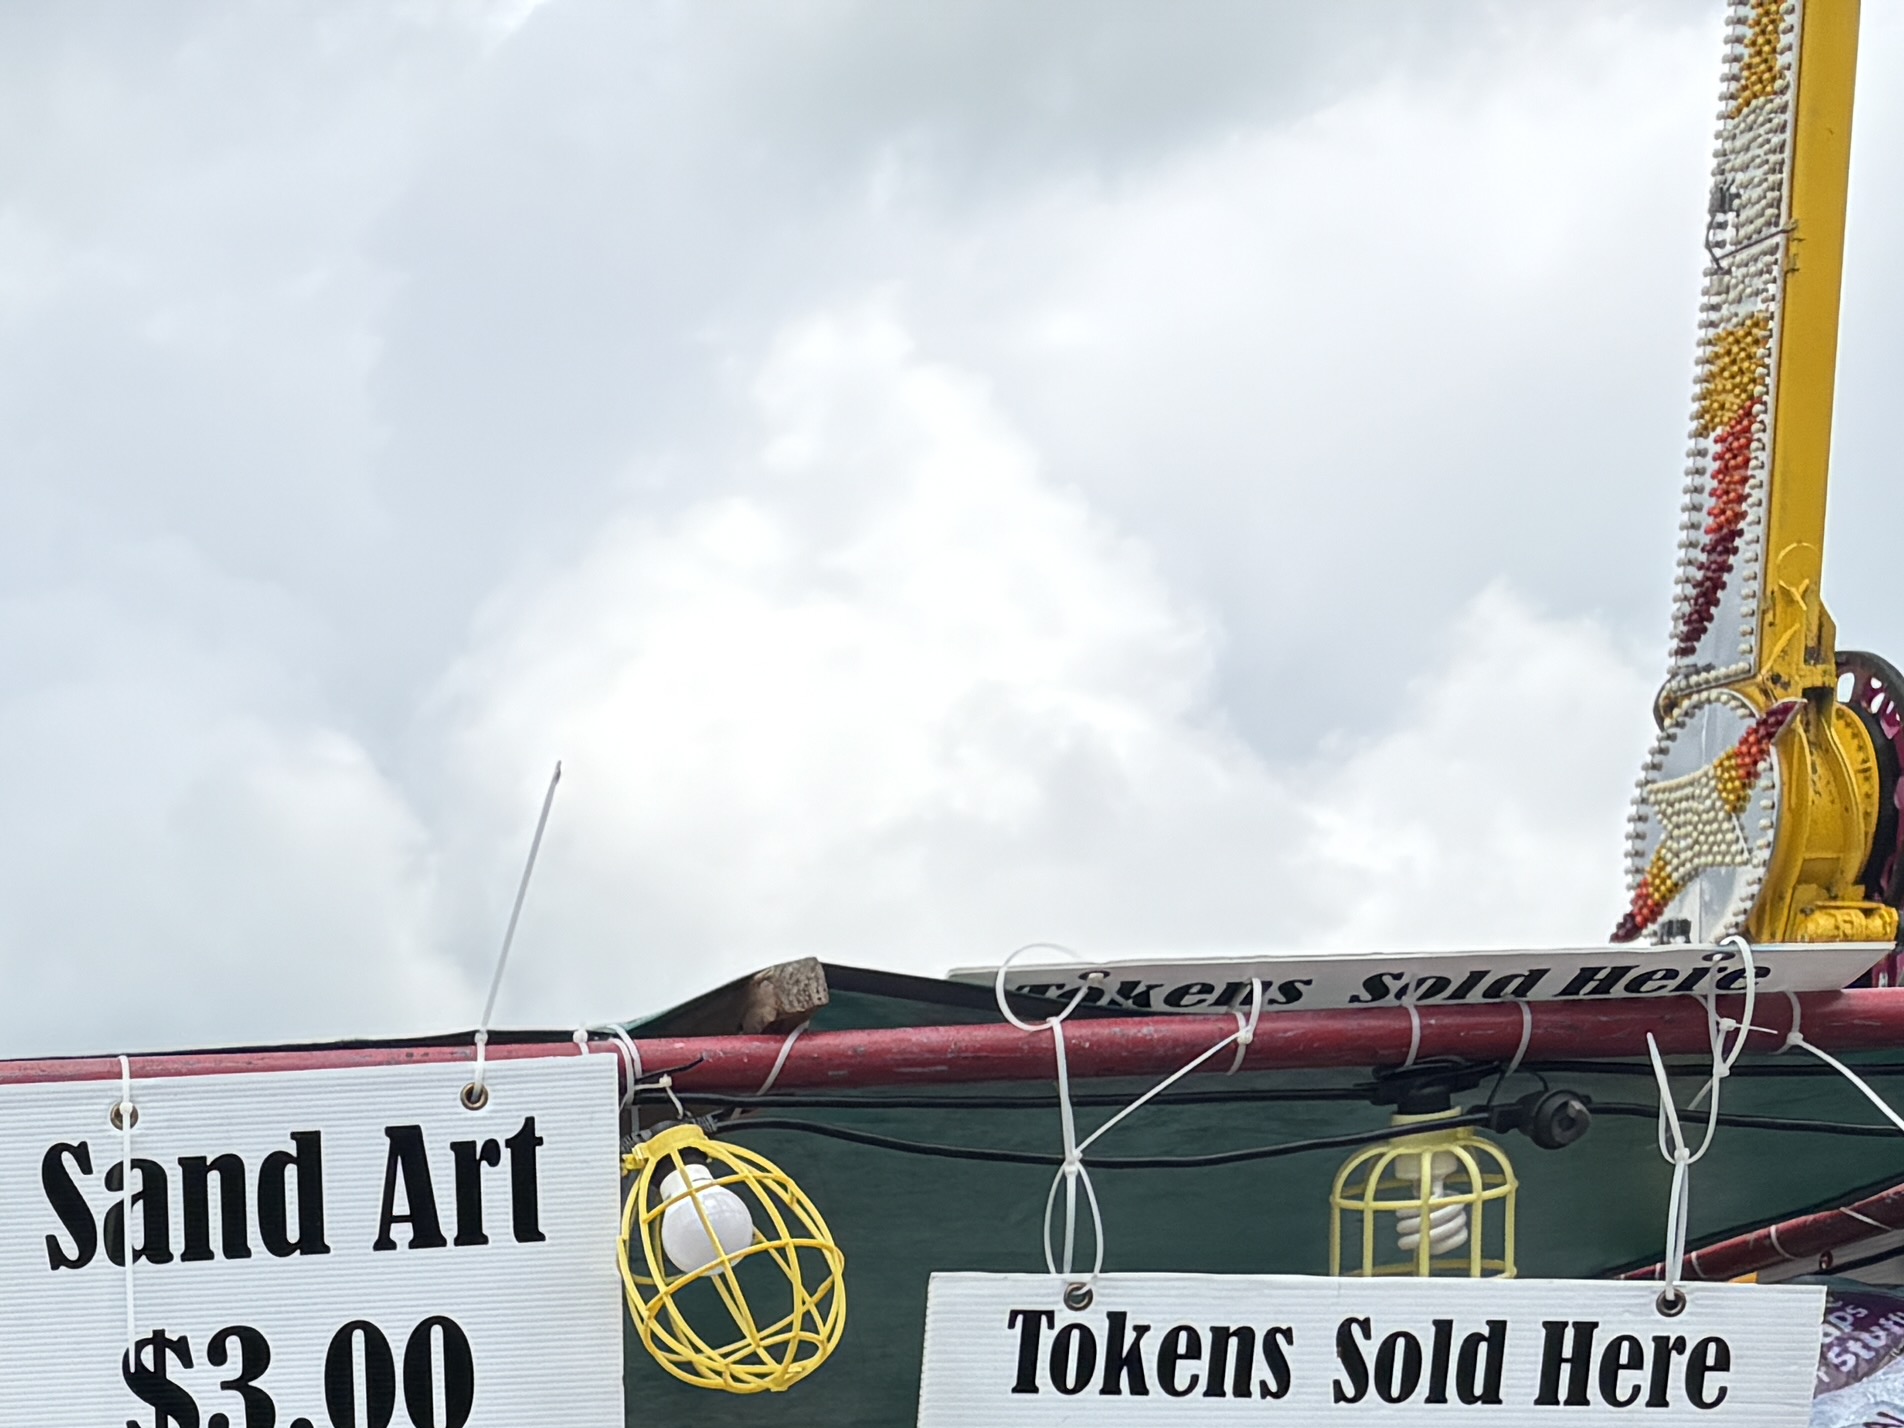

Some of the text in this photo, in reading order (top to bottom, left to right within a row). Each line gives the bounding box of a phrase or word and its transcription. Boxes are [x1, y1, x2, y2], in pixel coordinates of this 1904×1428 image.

[1348, 969, 1553, 1006] Sold
[1558, 956, 1772, 998] Here
[42, 1116, 545, 1270] Sand Art
[1008, 1309, 1731, 1409] Tokens Sold Here
